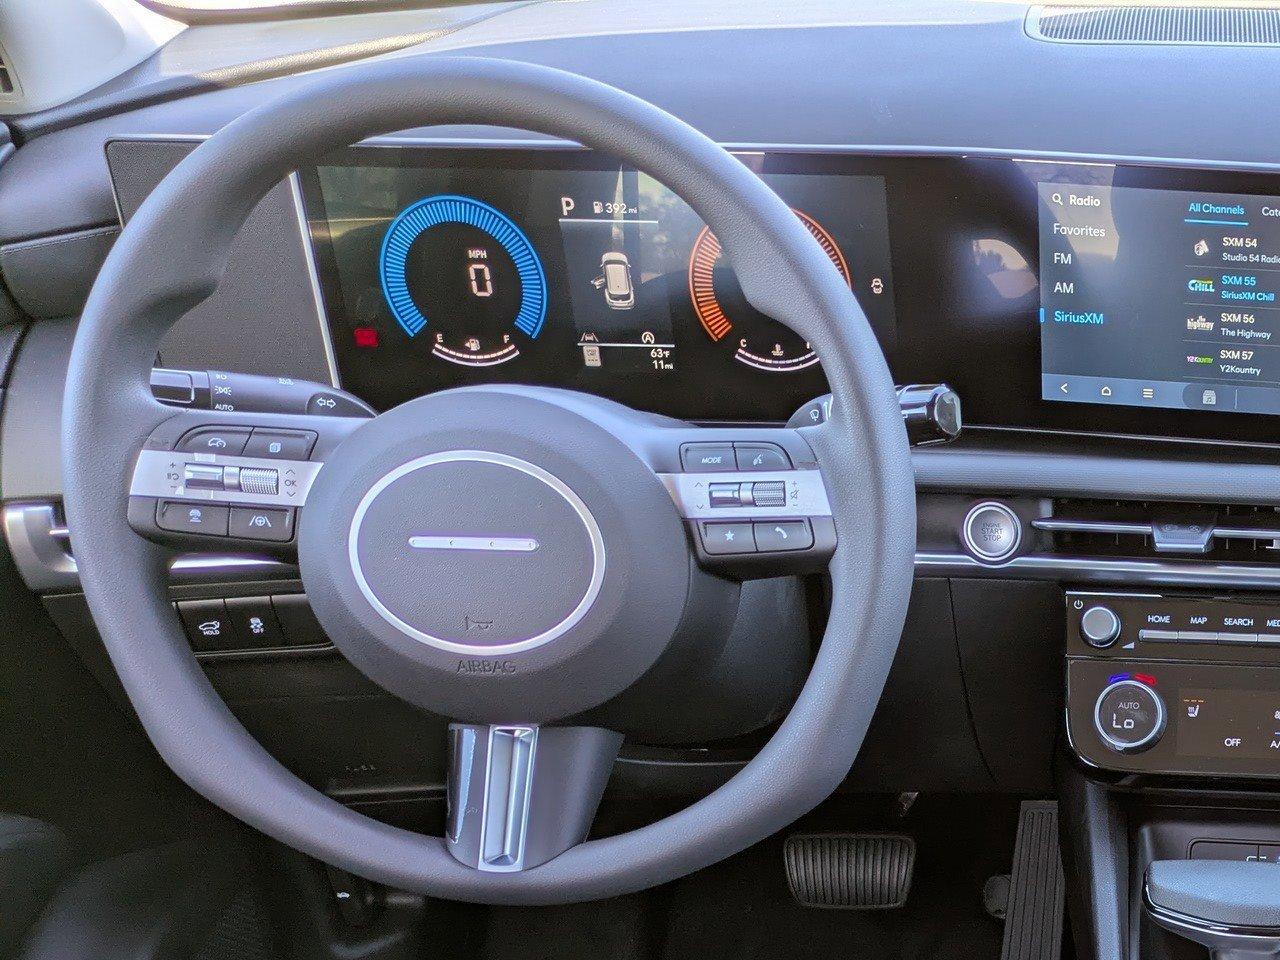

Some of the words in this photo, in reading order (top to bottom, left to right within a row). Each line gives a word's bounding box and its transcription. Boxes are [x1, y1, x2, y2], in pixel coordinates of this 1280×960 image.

[561, 197, 575, 216] P
[1069, 195, 1101, 207] Radio
[1188, 202, 1200, 212] All
[1202, 204, 1245, 215] Channels
[1053, 223, 1106, 237] Favorites
[1222, 237, 1244, 247] SXM
[1245, 238, 1257, 248] 54
[467, 249, 487, 259] MPH
[1053, 253, 1072, 264] FM
[1222, 252, 1247, 262] Studio
[1249, 254, 1259, 263] 54
[469, 264, 493, 297] 0
[1221, 275, 1243, 285] SXM
[1244, 277, 1256, 286] 55
[1053, 282, 1074, 294] AM
[1221, 291, 1256, 300] SiriusXM
[1054, 310, 1104, 324] SiriusXM
[1221, 313, 1242, 323] SXM
[1242, 314, 1255, 324] 56
[436, 333, 444, 343] E
[503, 334, 510, 344] F
[1221, 328, 1236, 337] The
[1237, 329, 1272, 340] Highway
[739, 338, 747, 348] C
[1220, 350, 1240, 360] SXM
[1242, 351, 1254, 360] 57
[1220, 365, 1261, 376] Y2Kountry
[701, 456, 722, 464] MODE
[284, 479, 297, 487] OK
[983, 534, 1002, 542] STOP
[1147, 615, 1171, 624] HOME
[1190, 617, 1207, 625] MAP
[1223, 618, 1254, 627] SEARCH
[456, 660, 516, 675] AIRBAG
[1117, 701, 1140, 710] AUTO
[1224, 738, 1241, 747] OFF
